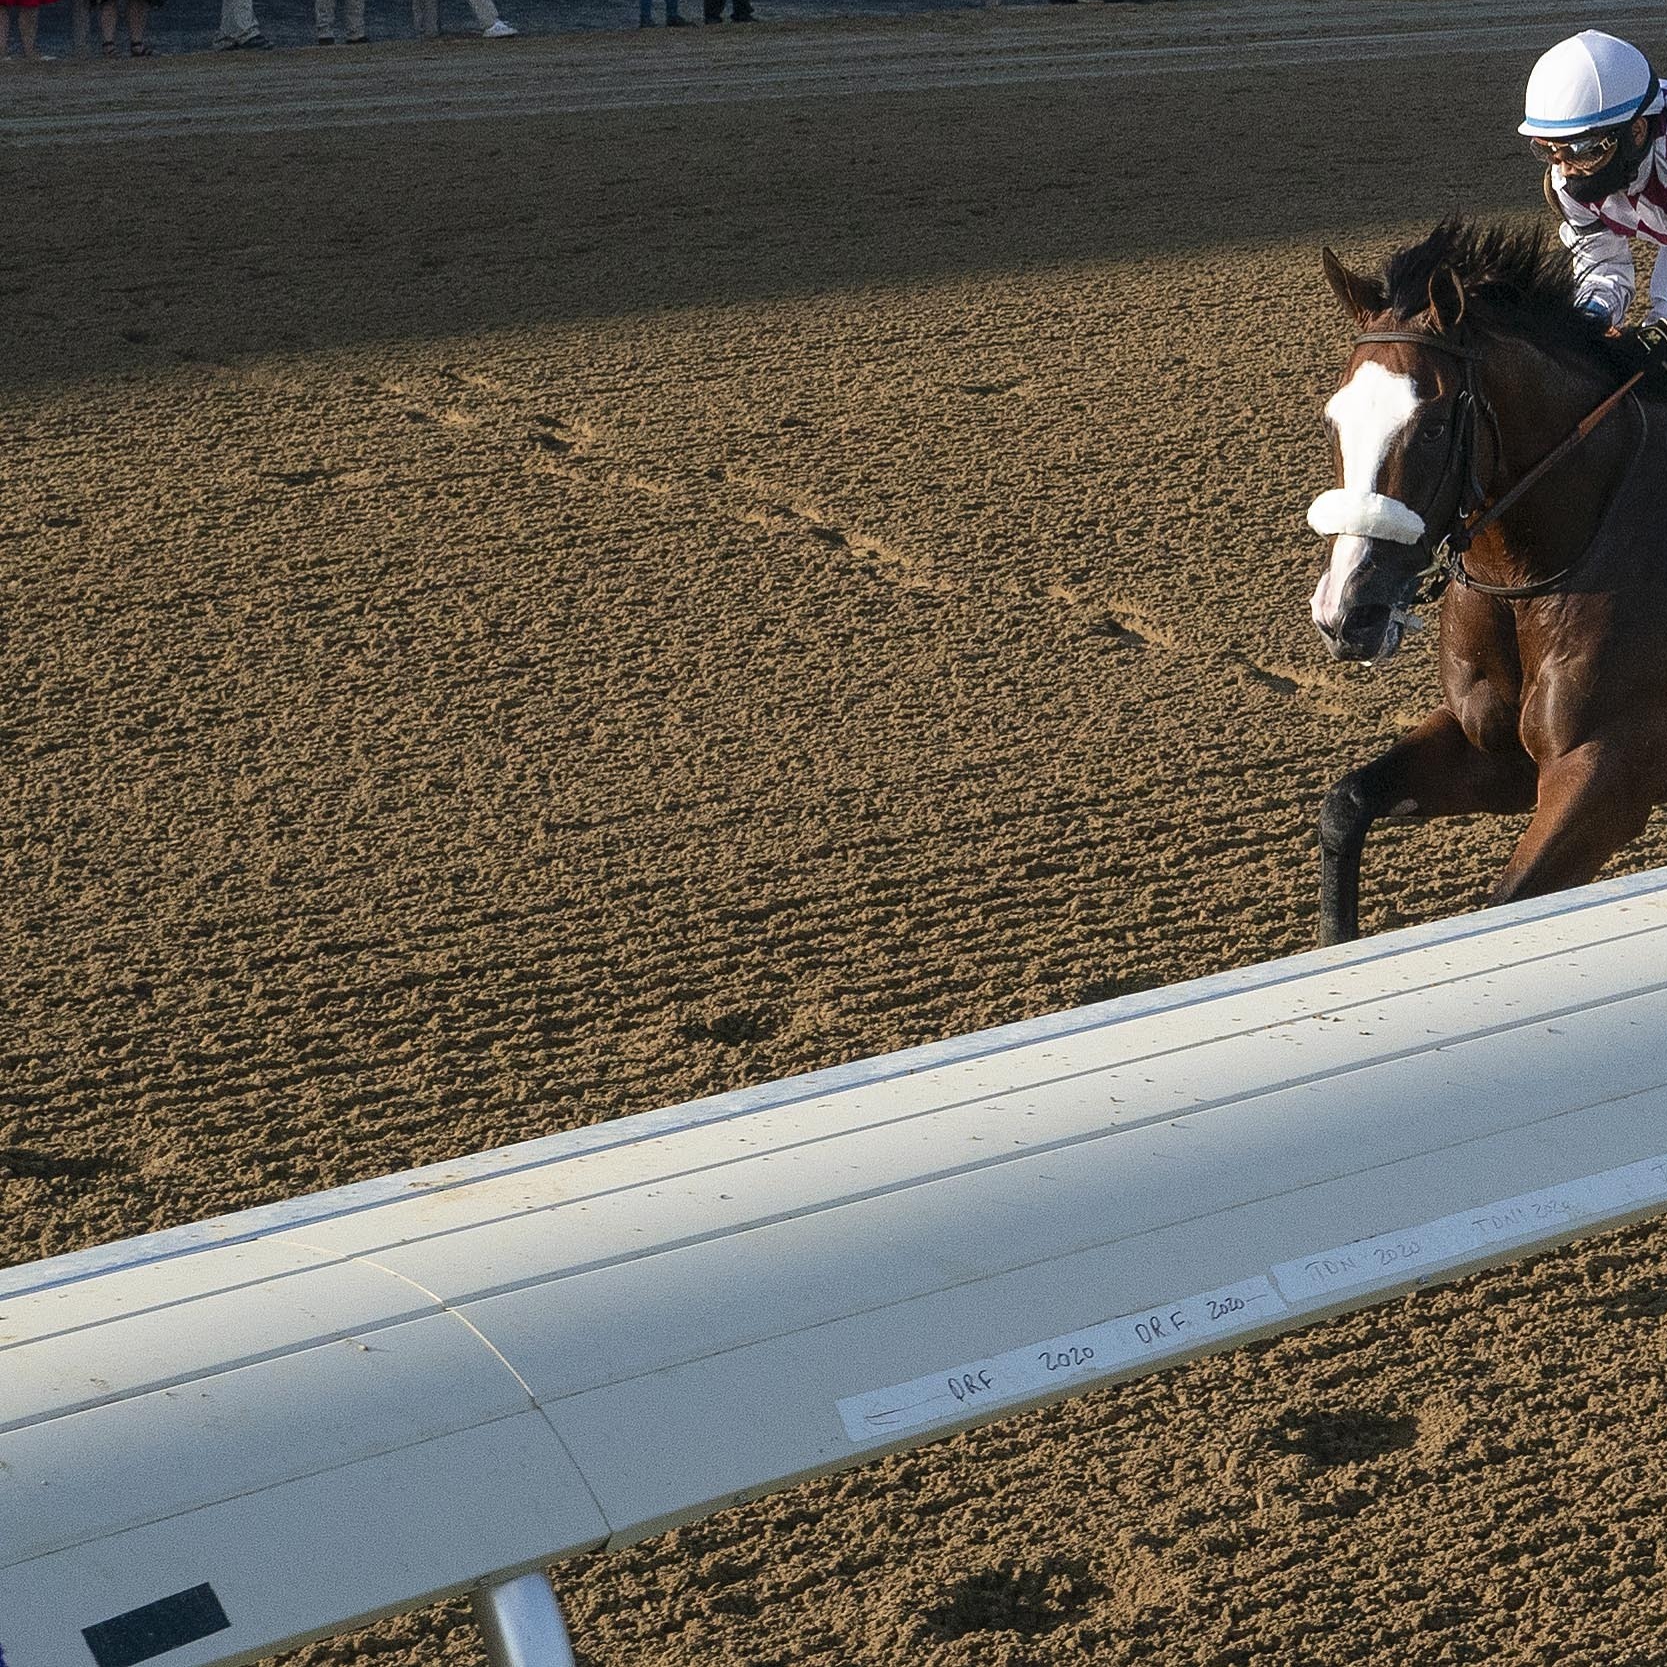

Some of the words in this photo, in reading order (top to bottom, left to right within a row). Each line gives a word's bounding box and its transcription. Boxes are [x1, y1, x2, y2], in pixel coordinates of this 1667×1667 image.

[1305, 1256, 1358, 1282] TDN
[1373, 1241, 1421, 1266] 2020
[947, 1369, 994, 1402] DRF
[1038, 1347, 1095, 1371] 2020
[1206, 1297, 1245, 1321] 2020
